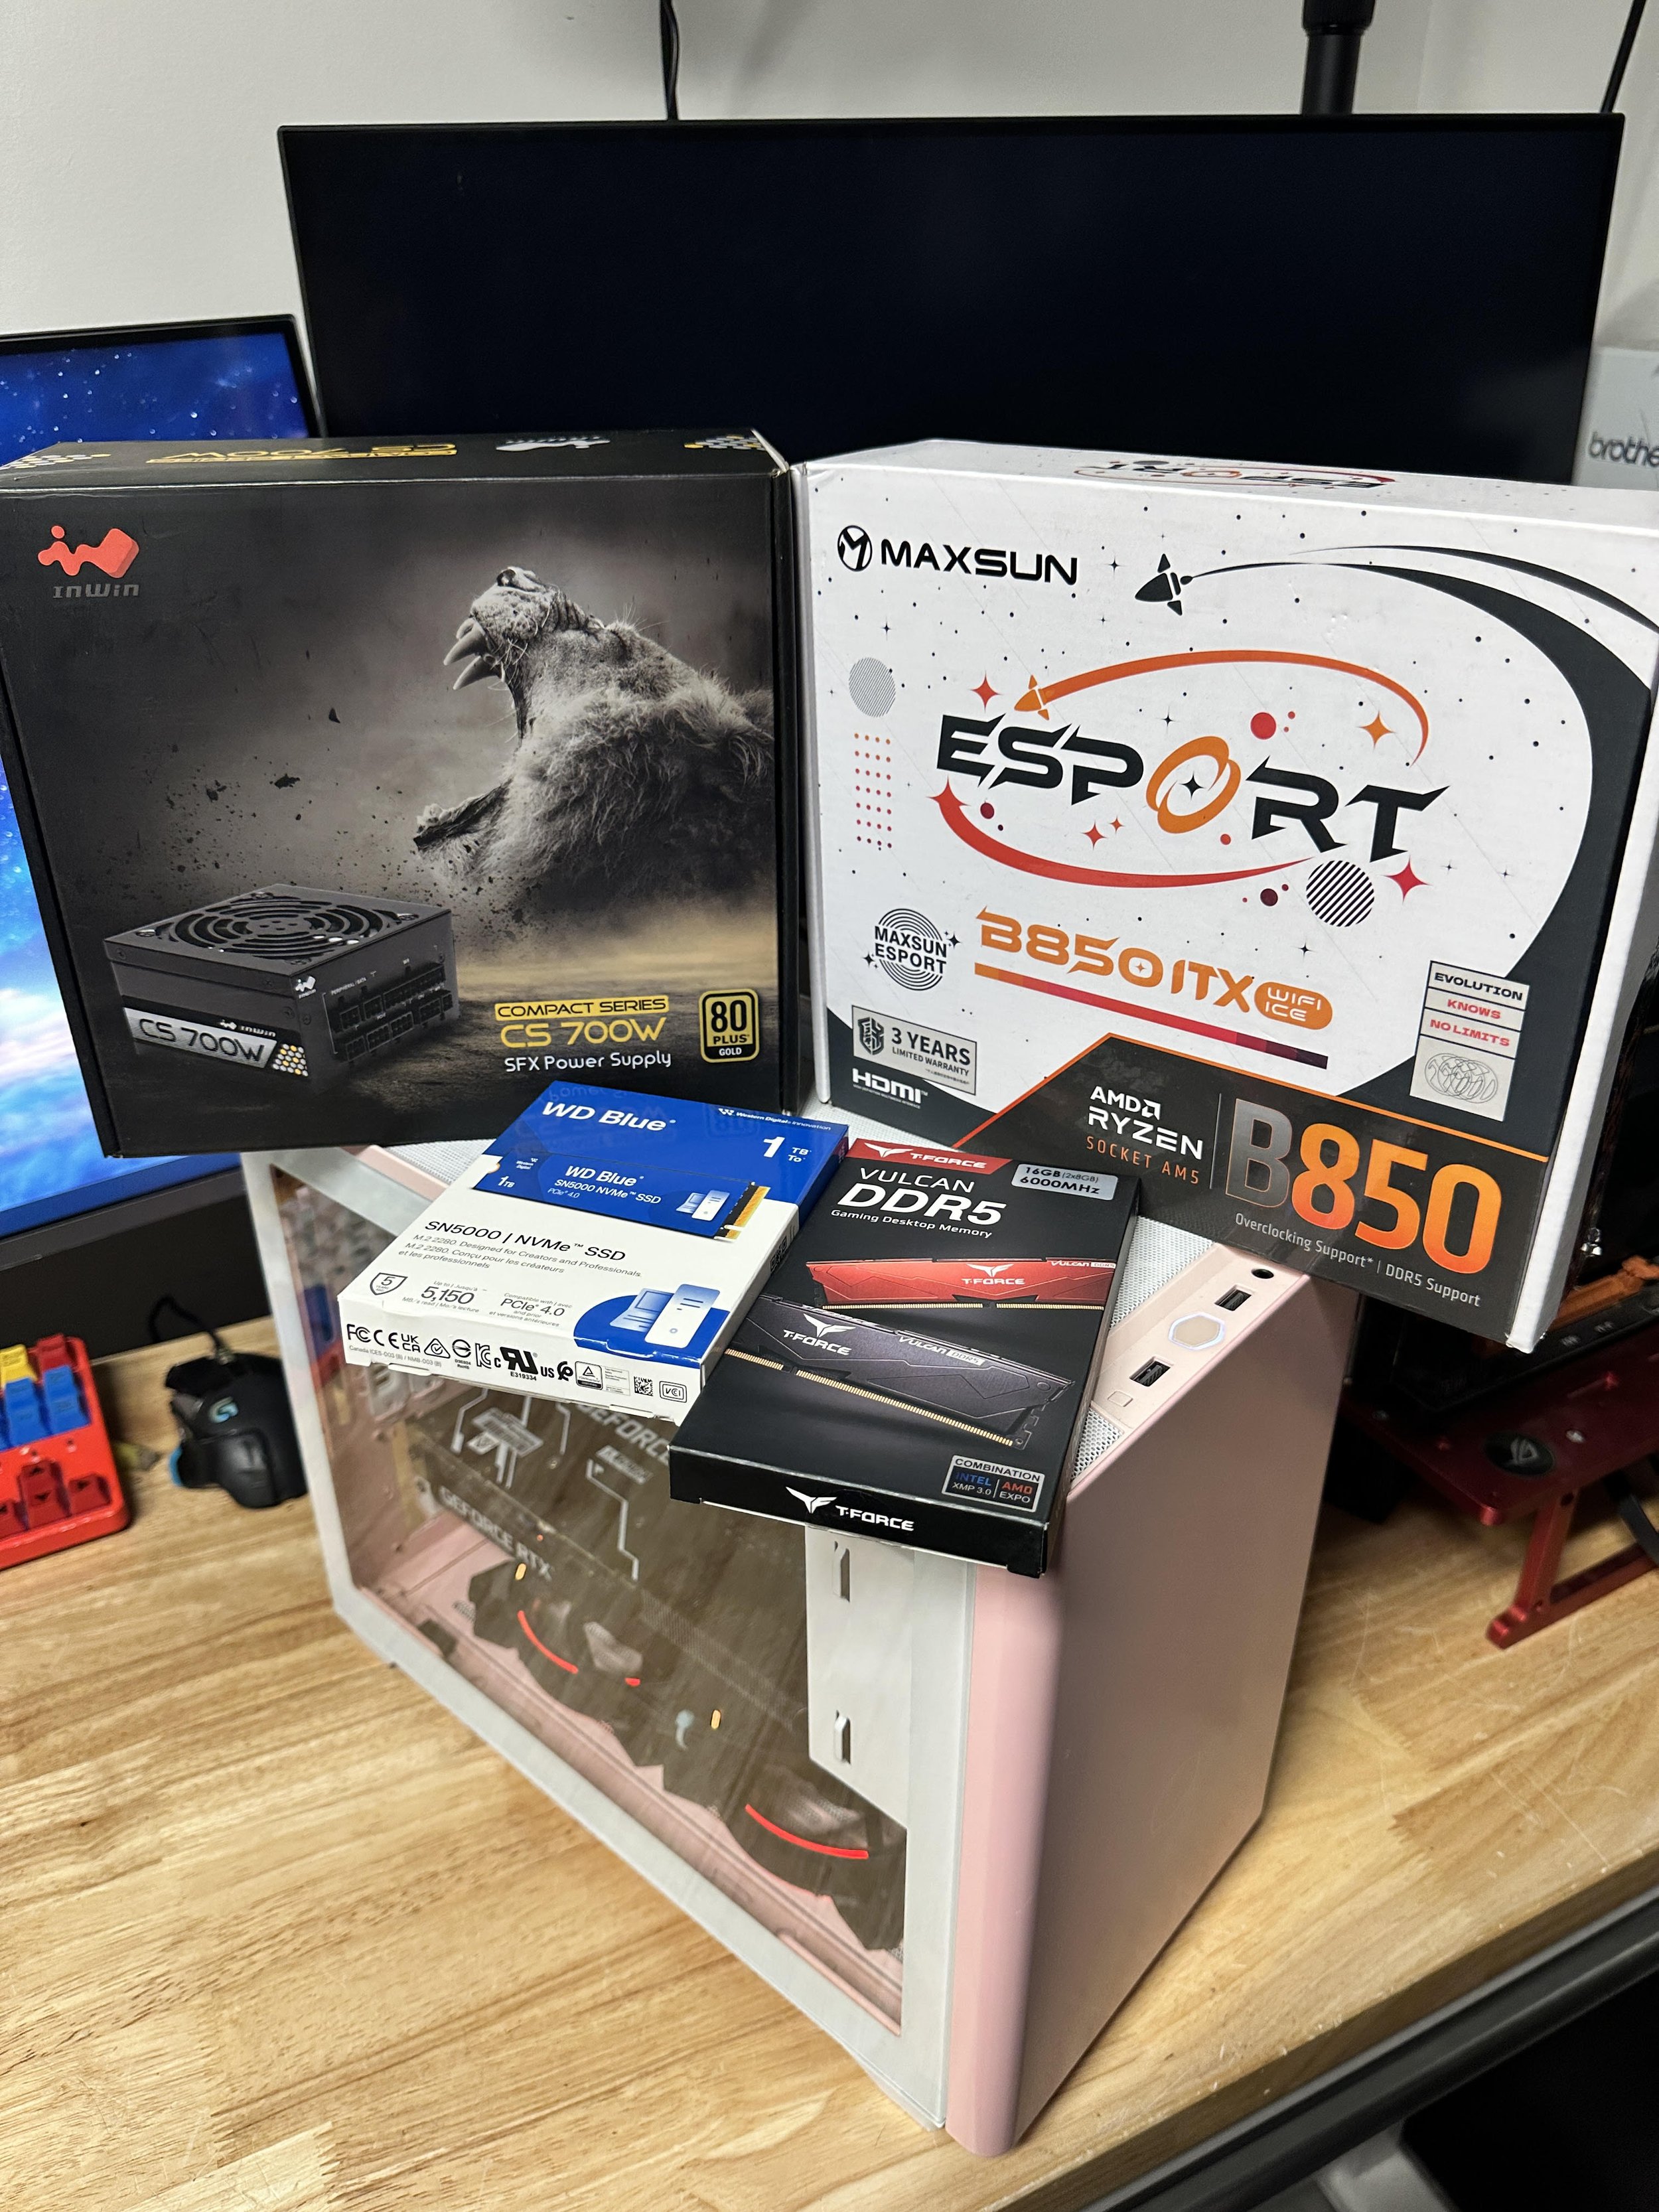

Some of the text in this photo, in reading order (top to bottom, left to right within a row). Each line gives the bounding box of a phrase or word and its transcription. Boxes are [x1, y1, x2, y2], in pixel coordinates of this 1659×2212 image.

[1589, 431, 1659, 467] brothe
[881, 538, 1078, 585] MAXSUN
[936, 713, 1451, 863] ESPORT
[875, 926, 948, 958] MAXSUN
[875, 942, 947, 975] ESPORT
[975, 905, 1254, 1013] B850 ITX
[1266, 986, 1323, 1011] WIFI
[1434, 972, 1523, 1001] EVOLUTION
[498, 998, 666, 1017] COMPACT SERIES
[711, 999, 748, 1033] 80
[1265, 1001, 1307, 1023] ICE
[1447, 999, 1501, 1019] KNOWS
[139, 1018, 265, 1063] CS 700W
[500, 1017, 667, 1049] CS 700W
[713, 1033, 750, 1045] PLUS
[1429, 1019, 1510, 1047] NO LIMITS
[719, 1047, 743, 1057] GOLD
[891, 1027, 971, 1066] 3 YEARS
[504, 1051, 672, 1072] SFX Power Supply
[892, 1047, 924, 1063] LIMITED
[924, 1057, 970, 1077] WARRANTY
[542, 1102, 596, 1120] WD
[1090, 1085, 1141, 1114] AMD
[736, 1112, 764, 1121] Western
[1088, 1104, 1204, 1161] RYZEN
[763, 1136, 786, 1158] 1
[565, 1165, 596, 1179] WD
[1086, 1136, 1200, 1185] SOCKET AM5
[860, 1167, 975, 1194] VULCAN
[1019, 1175, 1102, 1195] 6000MHz
[1024, 1165, 1100, 1184] 16GB (2x8GB)
[1225, 1098, 1502, 1275] B850
[554, 1179, 596, 1193] SN5000
[634, 1193, 662, 1205] SSD
[837, 1182, 1007, 1226] DDR5
[831, 1209, 993, 1239] Gaming Desktop Memory
[425, 1220, 502, 1240] SN5000
[584, 1246, 626, 1262] SSD
[459, 1240, 503, 1253] Designed
[518, 1250, 558, 1262] Creators
[558, 1256, 579, 1266] and
[423, 1253, 491, 1270] professionnels
[451, 1248, 482, 1260] Conçu
[481, 1254, 505, 1265] pour
[521, 1261, 565, 1274] créateurs
[1235, 1213, 1312, 1252] Overclocking
[1385, 1263, 1423, 1288] DDR5
[1425, 1277, 1481, 1308] Support
[380, 1276, 396, 1286] 5
[421, 1286, 476, 1305] 5,150
[540, 1305, 566, 1317] 4.0
[899, 1336, 981, 1365] VULCAN DDR5
[510, 1371, 537, 1381] E319334
[955, 1457, 1041, 1483] COMBINATION
[956, 1471, 992, 1487] INTEL
[952, 1481, 992, 1496] XMP 3.0
[999, 1491, 1031, 1504] EXPO
[1001, 1481, 1033, 1495] AMD
